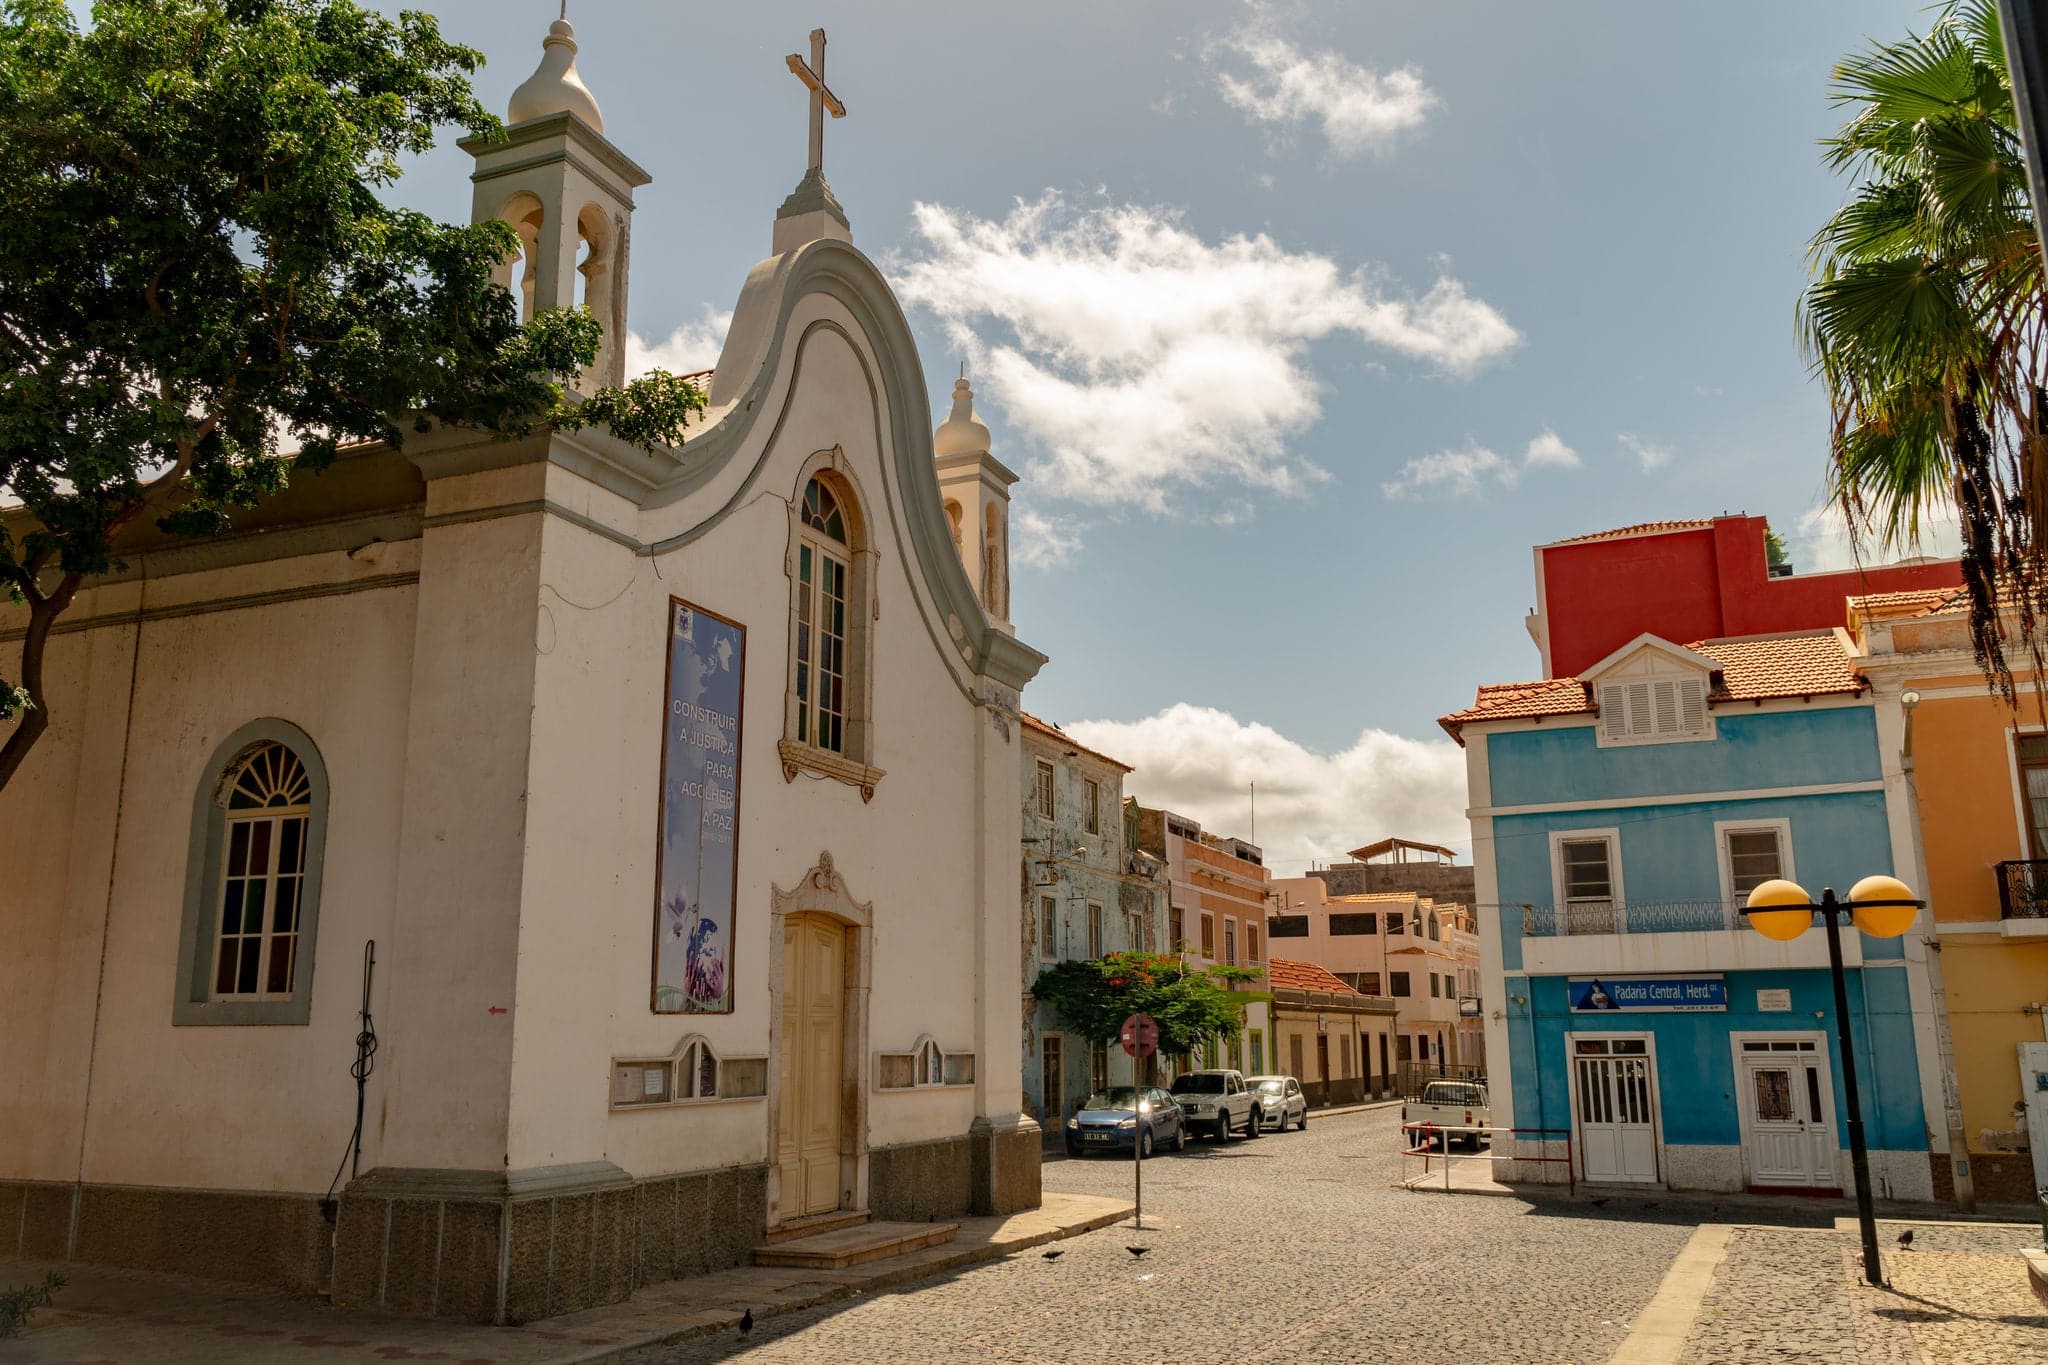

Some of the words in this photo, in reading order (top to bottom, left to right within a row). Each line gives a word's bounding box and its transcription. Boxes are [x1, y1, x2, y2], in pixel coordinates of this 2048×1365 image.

[673, 699, 736, 732] CONSTRUIR
[679, 727, 688, 743] A
[690, 731, 735, 757] JUSTIÇA
[705, 760, 734, 781] PARA
[681, 780, 734, 805] ACOLHER
[702, 811, 711, 826] A
[712, 814, 733, 831] PAZ
[1614, 985, 1647, 1000] Padaria
[1649, 983, 1684, 1001] Central,
